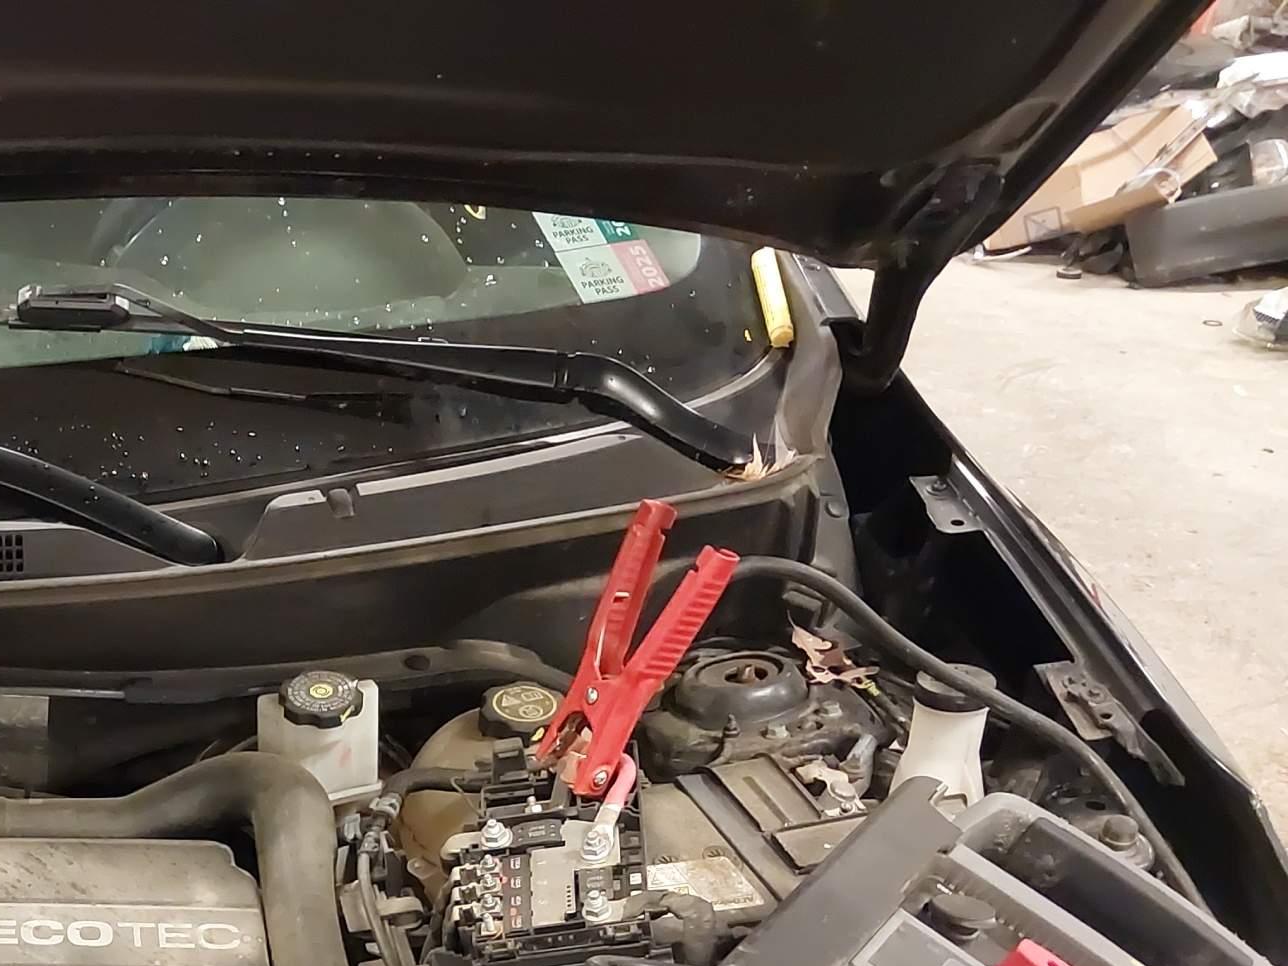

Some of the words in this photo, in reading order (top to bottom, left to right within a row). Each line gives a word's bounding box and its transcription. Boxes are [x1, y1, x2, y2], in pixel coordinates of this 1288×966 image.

[552, 226, 594, 239] PARKING
[566, 235, 589, 245] PASS
[630, 245, 665, 288] 2025
[581, 276, 624, 289] PARKING
[594, 286, 620, 296] PASS
